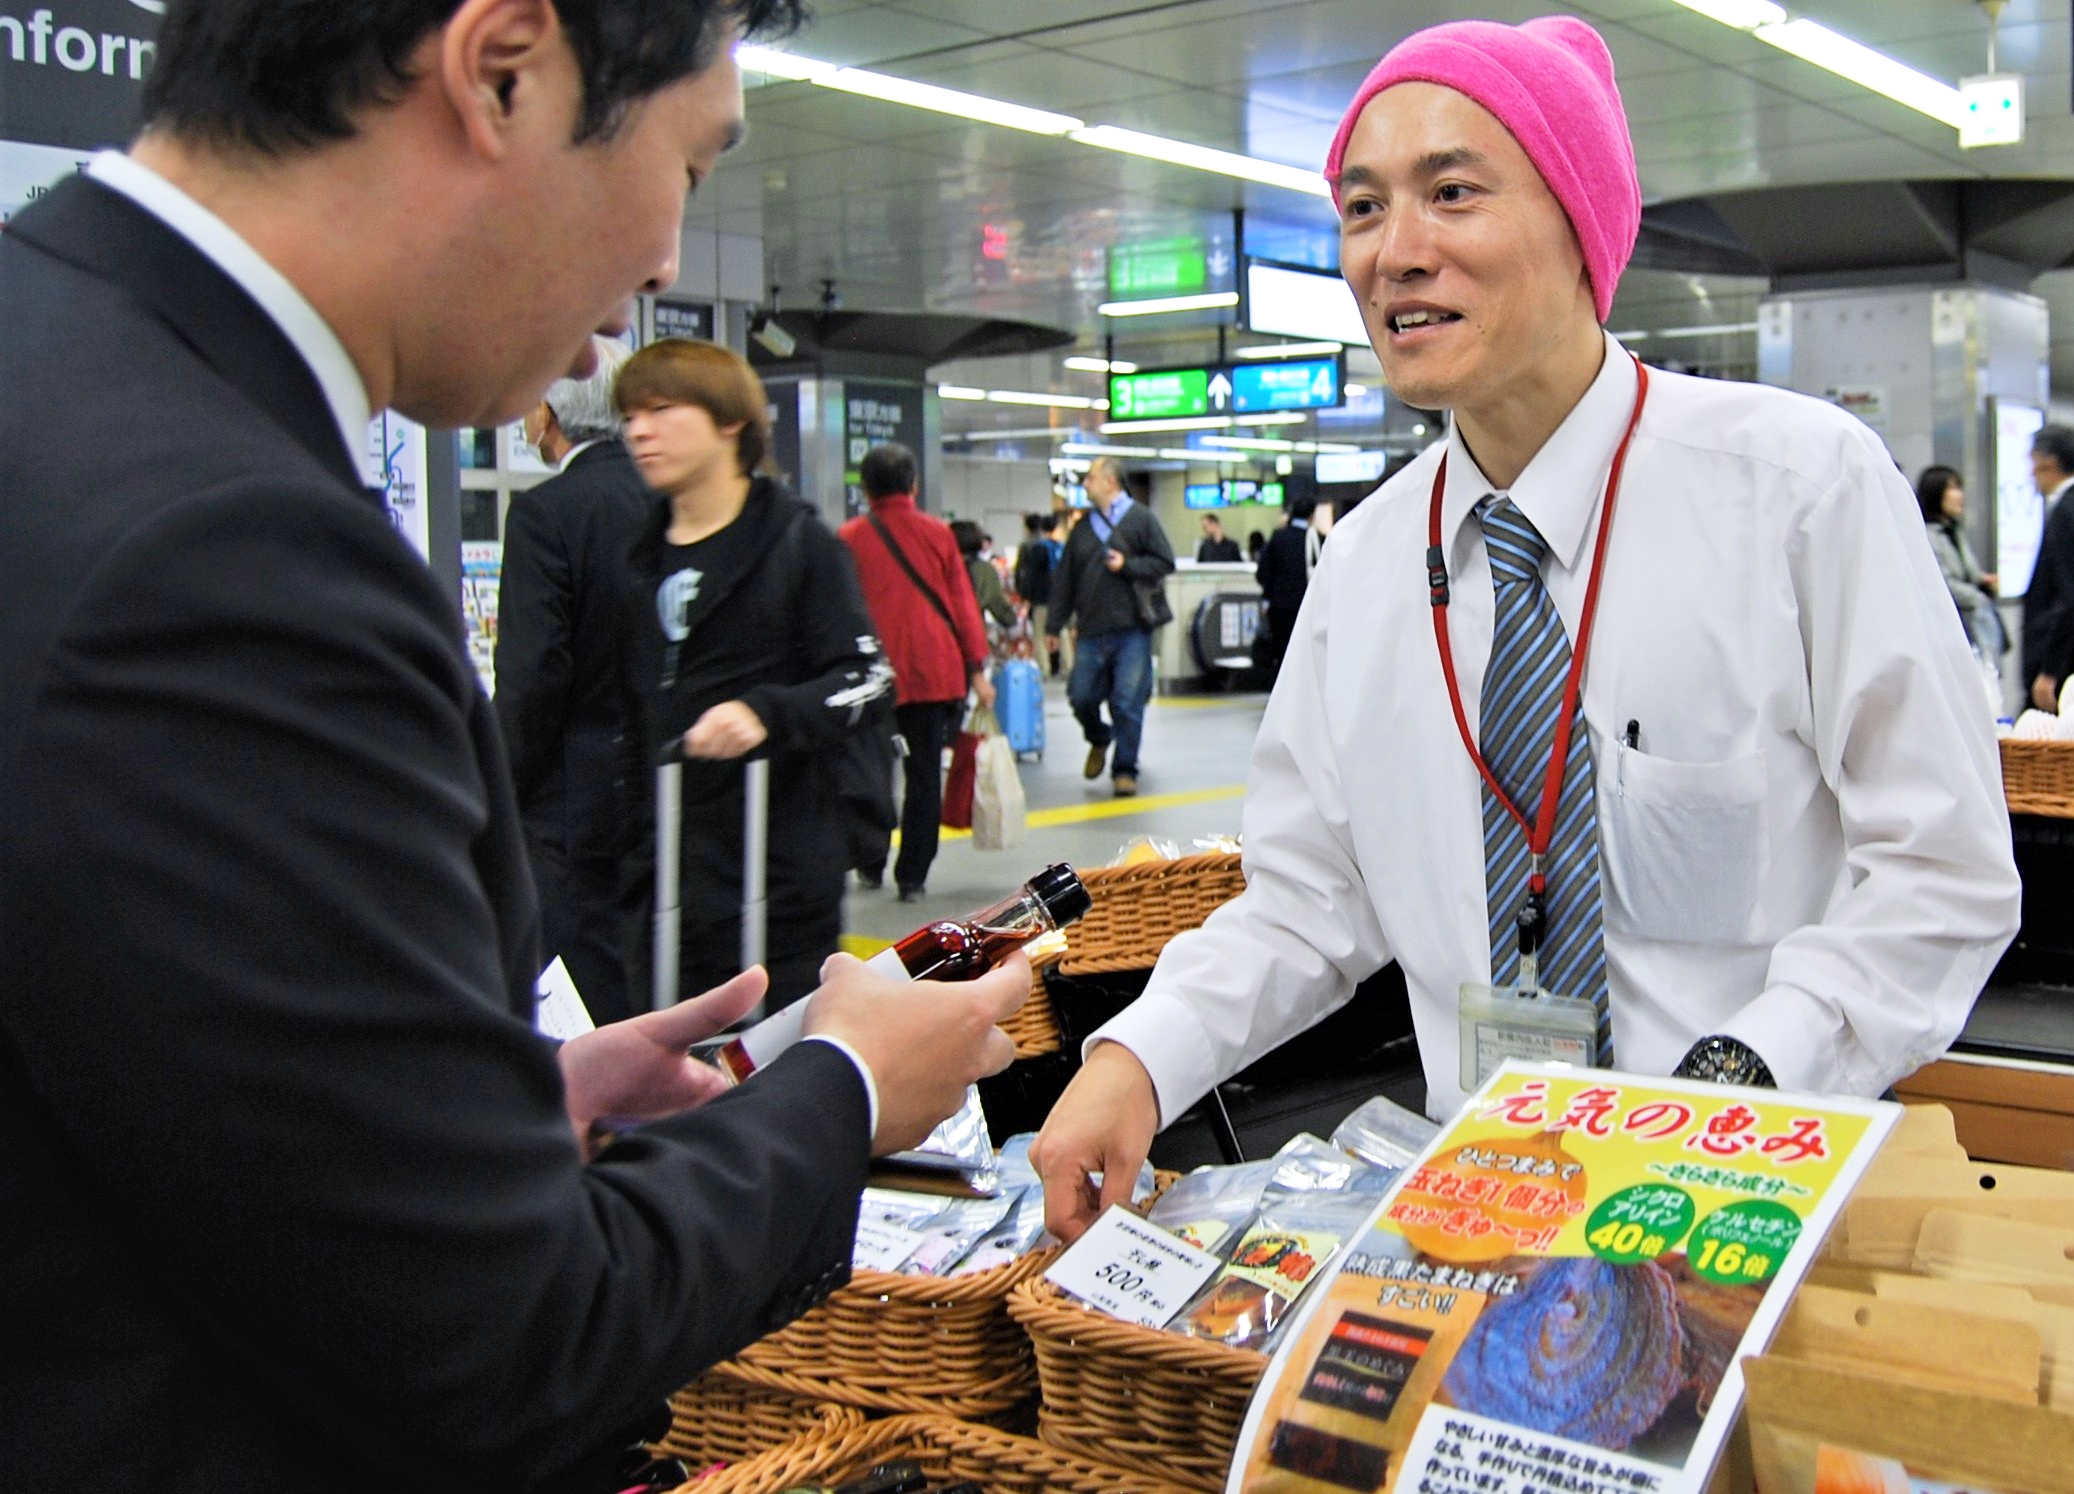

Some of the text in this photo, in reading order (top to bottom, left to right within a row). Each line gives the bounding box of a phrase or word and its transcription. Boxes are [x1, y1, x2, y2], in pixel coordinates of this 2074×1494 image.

[1115, 380, 1133, 415] 3
[1311, 367, 1332, 402] 4
[1477, 1083, 1826, 1163] 元気の恵み
[1456, 1147, 1583, 1181] ひとつまみで
[1608, 1200, 1682, 1227] アリイン
[1628, 1186, 1686, 1209] シクロ
[1588, 1220, 1666, 1258] 40倍
[1709, 1209, 1802, 1238] ケルセチン
[1696, 1238, 1770, 1279] 16倍
